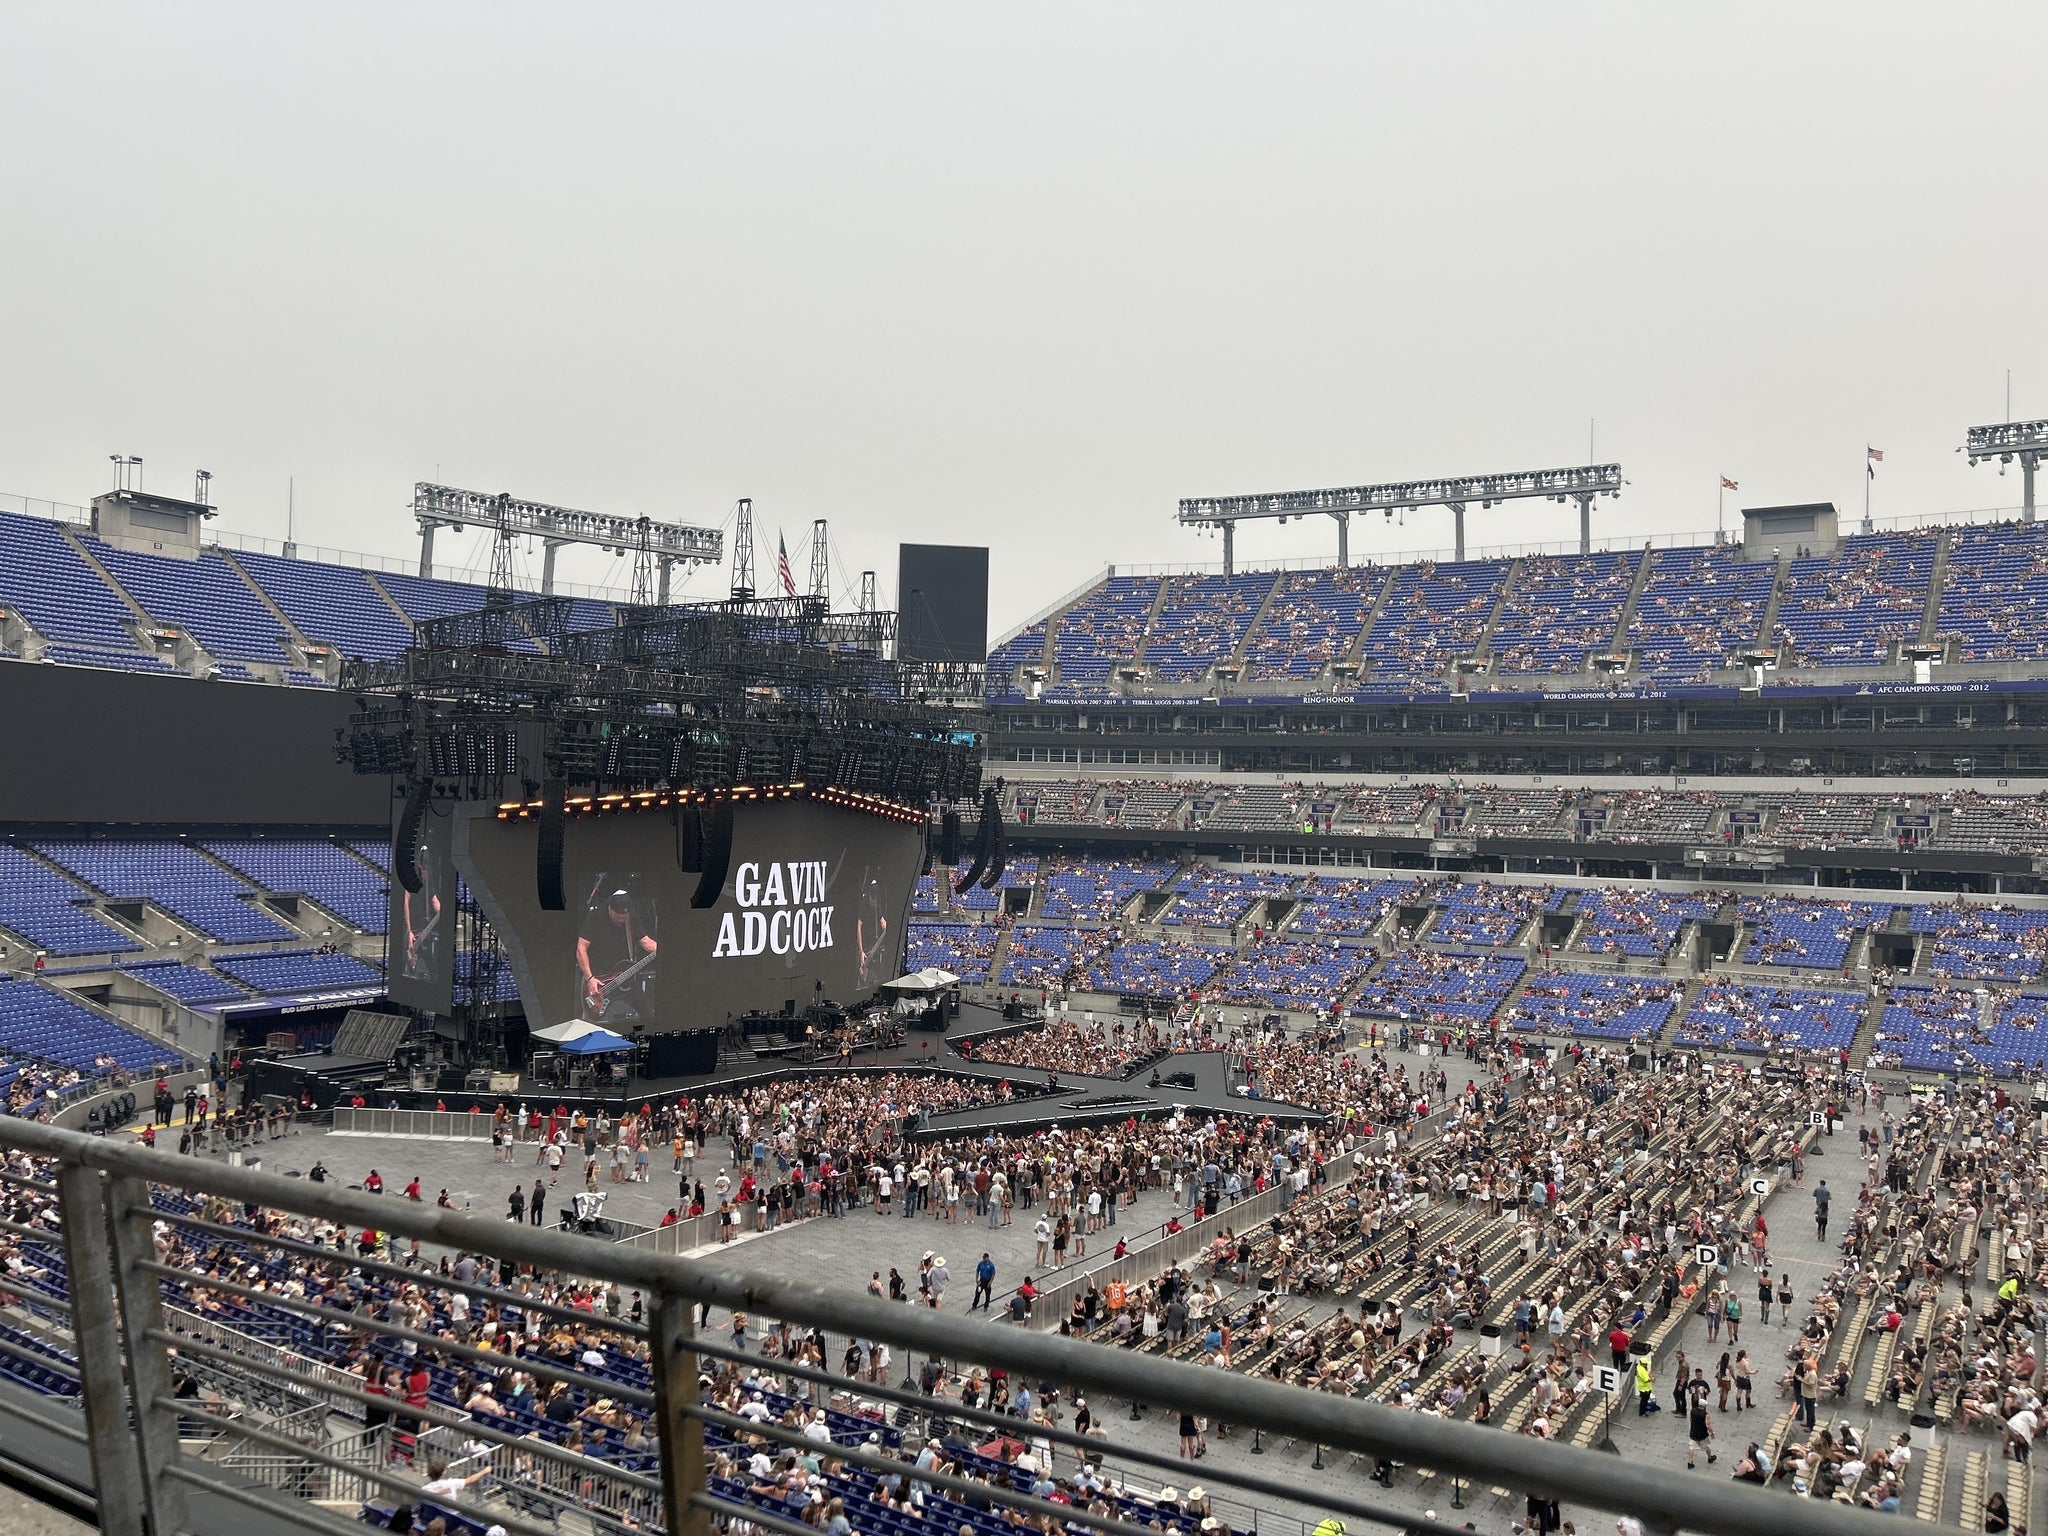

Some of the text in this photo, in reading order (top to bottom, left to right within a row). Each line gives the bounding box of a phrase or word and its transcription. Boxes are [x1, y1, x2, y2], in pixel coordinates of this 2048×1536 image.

[1894, 685, 1940, 693] CHAMPIONS
[735, 861, 827, 907] GAVIN
[712, 906, 834, 957] ADCOCK
[281, 1006, 296, 1014] BUD
[296, 1004, 316, 1012] LIGHT
[316, 999, 358, 1010] TOUCHDOWN
[357, 997, 375, 1005] CLUB
[1813, 1113, 1822, 1123] B
[1753, 1180, 1765, 1193] C
[1700, 1248, 1715, 1263] D
[1600, 1369, 1614, 1392] E
